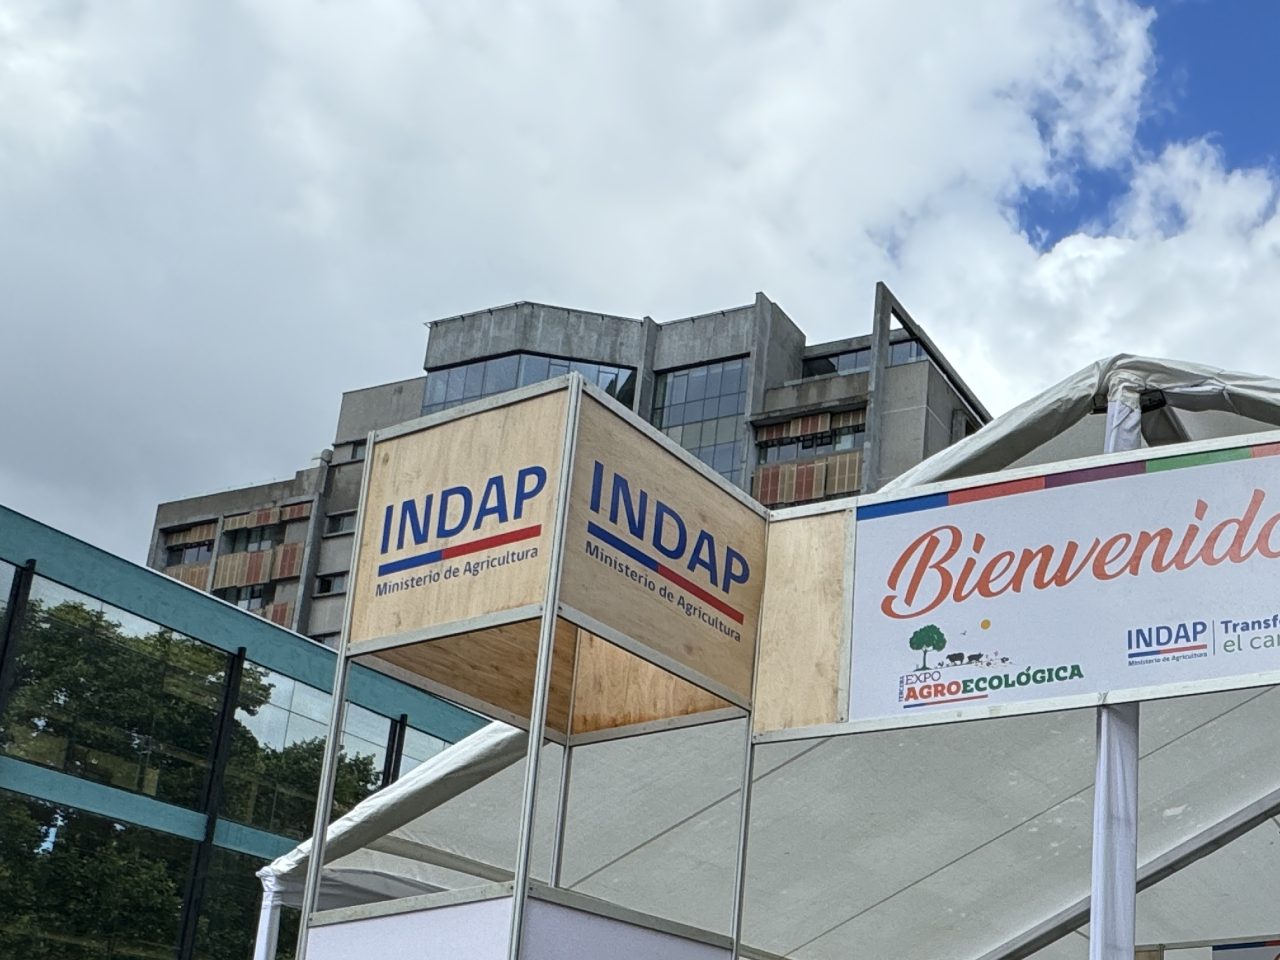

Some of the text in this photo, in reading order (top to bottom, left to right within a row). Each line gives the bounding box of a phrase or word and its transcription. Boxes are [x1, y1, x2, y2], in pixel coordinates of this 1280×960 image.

[380, 465, 547, 555] INDAP
[590, 460, 750, 594] INDAP
[375, 547, 538, 597] Ministerio de Agricultura
[585, 541, 741, 642] Ministerio de Agricultura
[1127, 621, 1207, 650] INDAP
[1223, 634, 1242, 653] el
[904, 664, 1085, 702] AGROECOLÓGICA
[905, 671, 941, 686] EXPO
